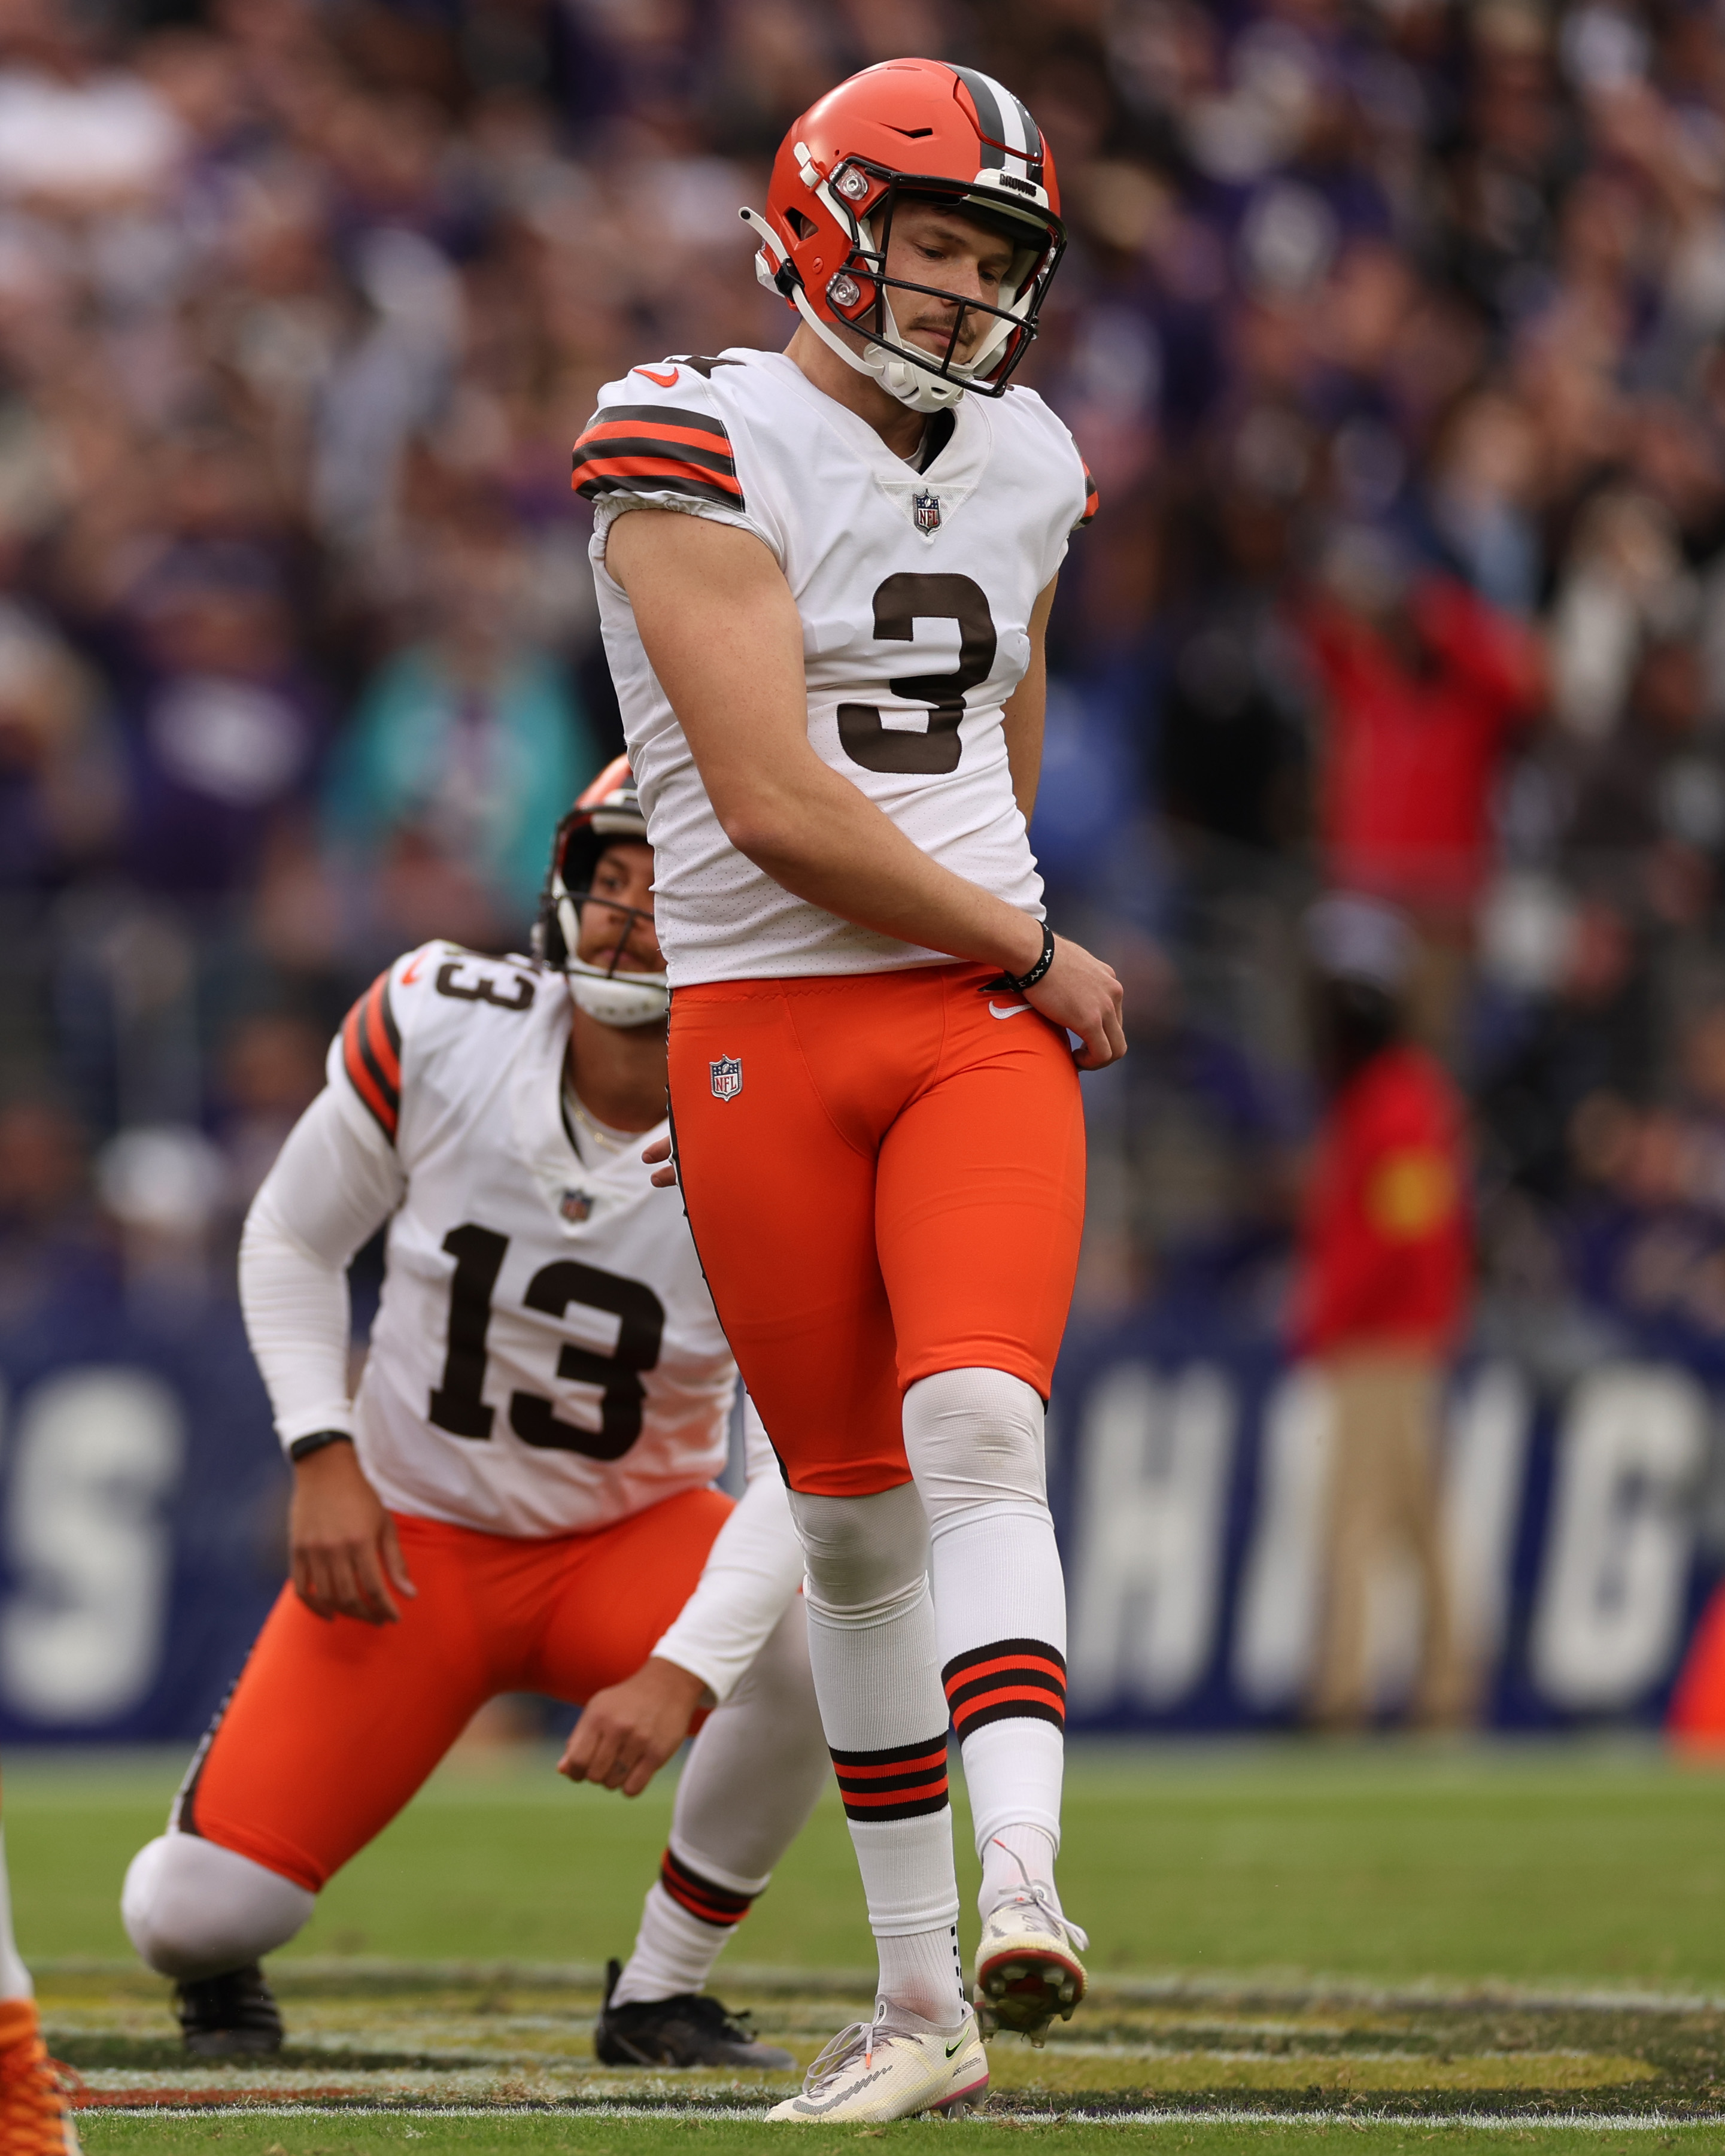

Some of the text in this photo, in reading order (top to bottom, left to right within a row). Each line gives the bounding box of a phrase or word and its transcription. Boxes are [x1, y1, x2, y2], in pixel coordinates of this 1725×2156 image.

[999, 174, 1037, 198] BROWNS
[919, 509, 938, 527] NFL
[837, 572, 998, 775] 3
[715, 1076, 737, 1092] NFL
[429, 1223, 666, 1462] 13
